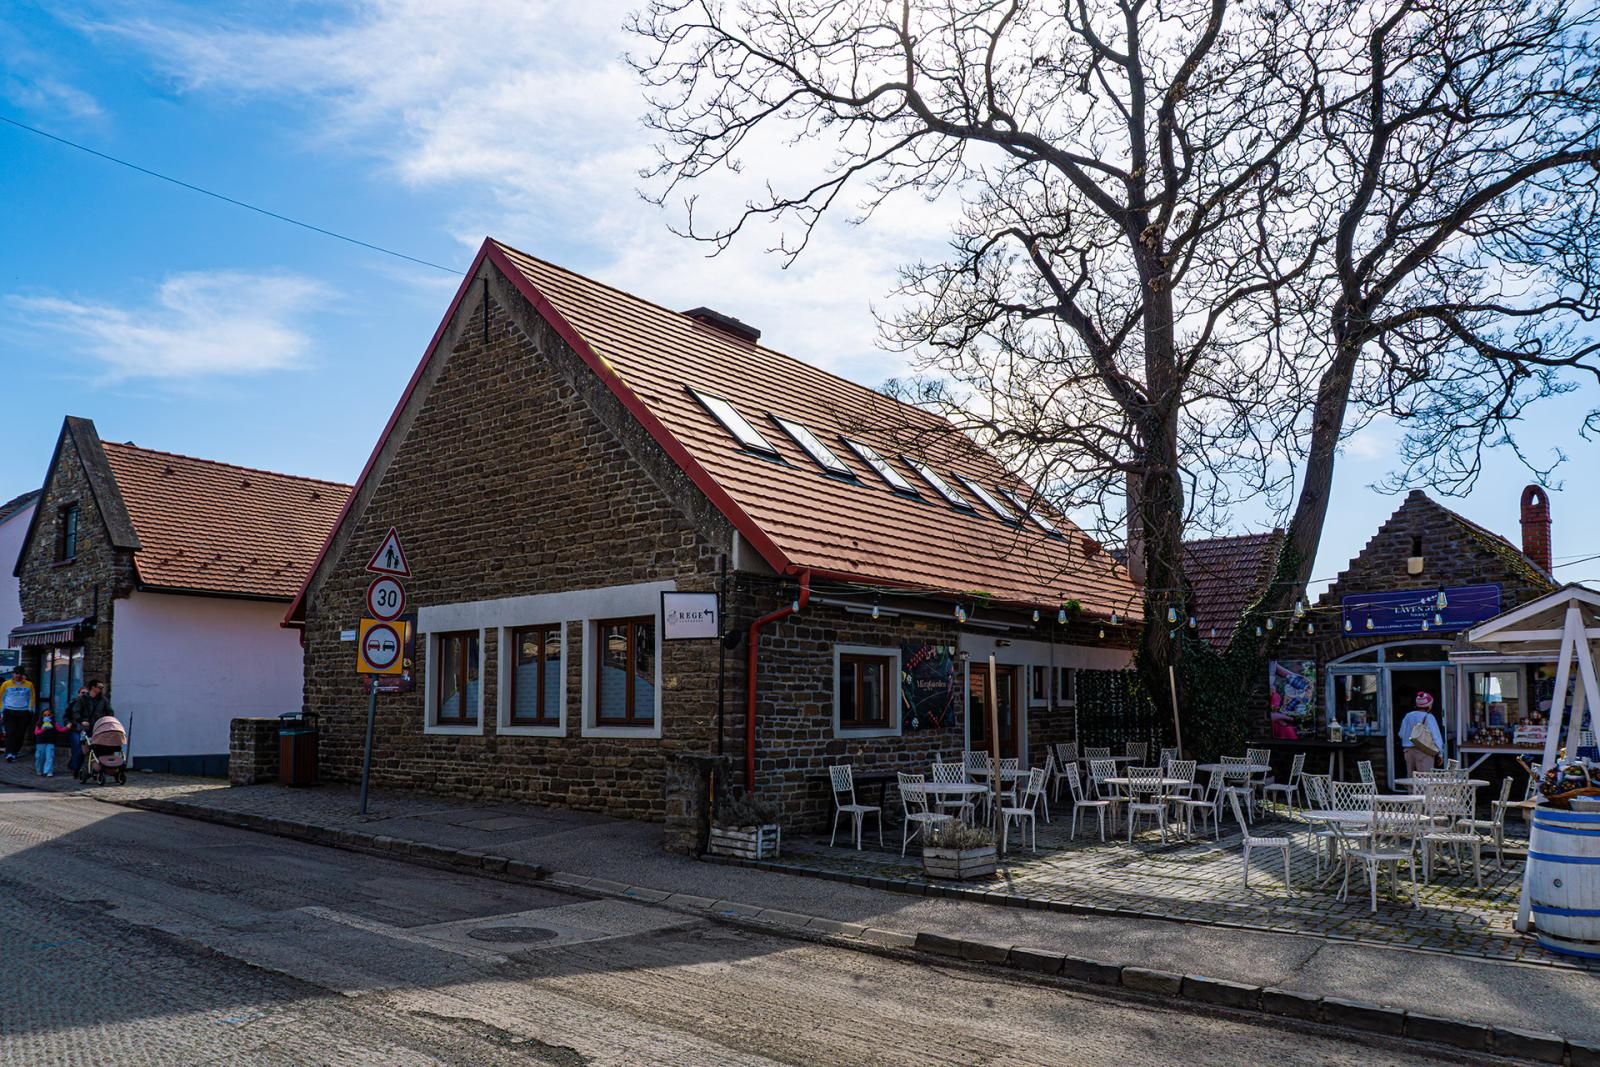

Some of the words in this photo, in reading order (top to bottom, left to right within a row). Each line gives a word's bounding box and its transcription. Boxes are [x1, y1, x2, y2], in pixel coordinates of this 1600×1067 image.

[377, 589, 397, 608] 30
[1394, 605, 1443, 614] LAVENDE
[679, 612, 704, 620] REGE
